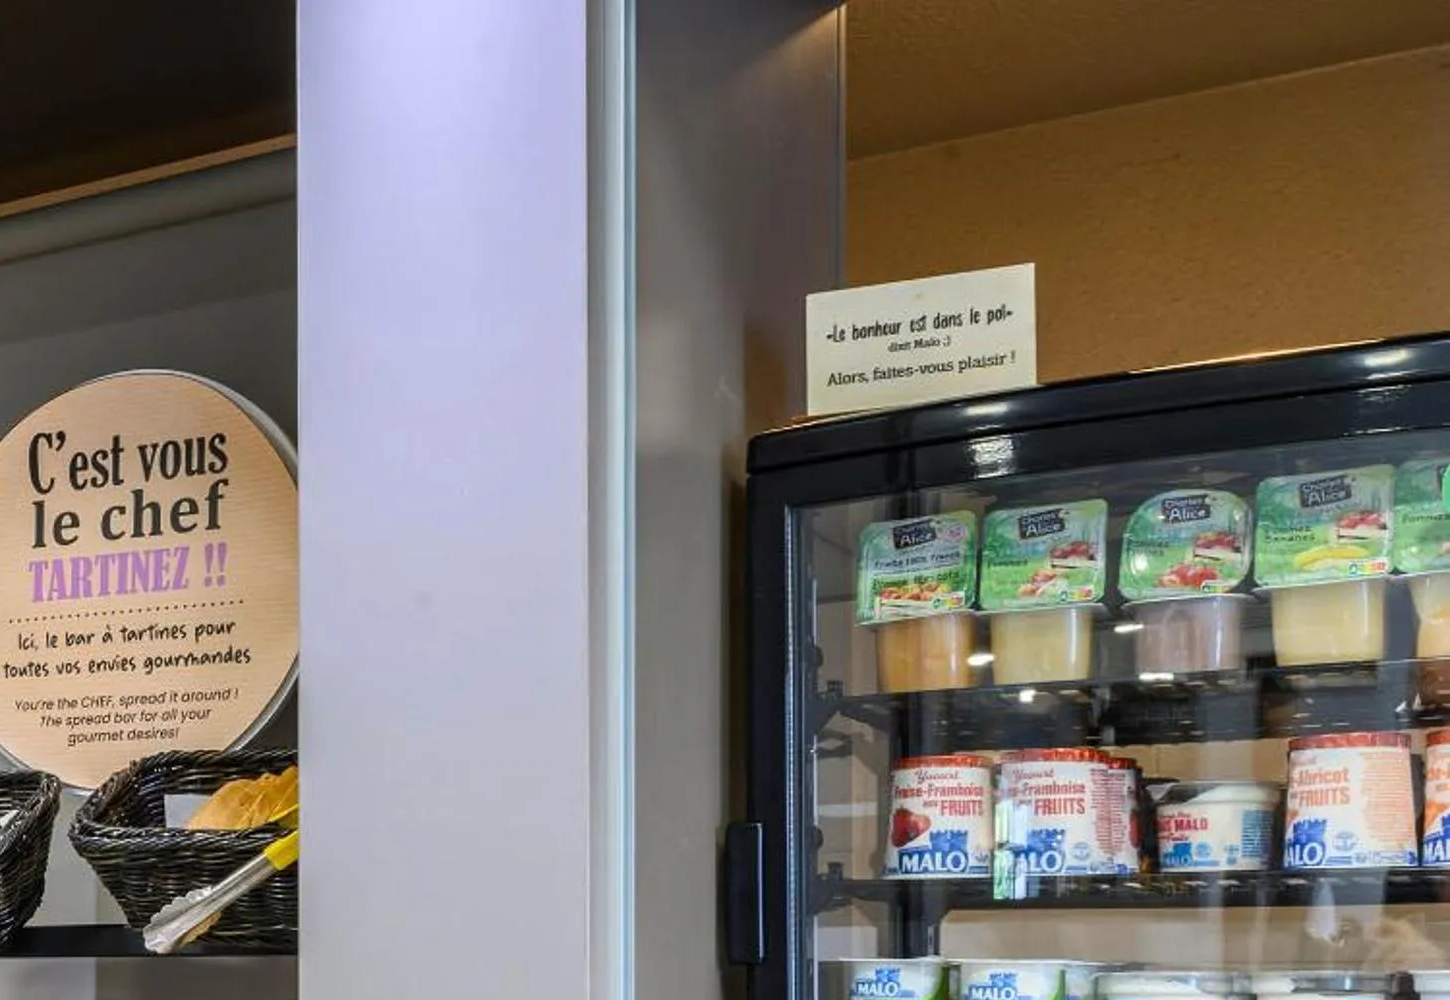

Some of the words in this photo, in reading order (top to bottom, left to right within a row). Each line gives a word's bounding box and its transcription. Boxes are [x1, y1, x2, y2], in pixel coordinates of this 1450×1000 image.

[852, 320, 902, 341] bonheur
[910, 315, 927, 332] est
[933, 311, 963, 330] dans
[970, 307, 981, 325] le
[827, 372, 869, 387] Alors,
[873, 360, 954, 381] faites-vous
[958, 354, 1007, 374] plaisir
[138, 432, 229, 481] vous
[32, 500, 80, 549] le
[101, 478, 229, 541] chef
[29, 546, 190, 603] TARTINEZ
[204, 542, 228, 588] !!
[45, 632, 58, 648] le
[65, 630, 95, 647] bar
[102, 625, 113, 643] à
[119, 623, 187, 642] tartines
[194, 621, 236, 642] pour
[3, 661, 49, 679] toutes
[55, 661, 81, 676] vos
[88, 656, 136, 672] envies
[143, 648, 251, 675] gourmandes
[57, 696, 78, 710] the
[119, 692, 166, 708] spread
[169, 691, 179, 703] it
[181, 688, 231, 703] around
[40, 714, 62, 728] The
[65, 712, 111, 729] spread
[113, 710, 137, 724] bar
[139, 709, 157, 724] for
[161, 708, 178, 722] all
[180, 707, 212, 725] your
[67, 730, 124, 747] gourmet
[1034, 798, 1086, 815] FRUITS
[902, 850, 967, 873] MALO
[1285, 842, 1324, 867] ALO
[856, 981, 899, 998] MALO
[971, 986, 1017, 1000] MALO
